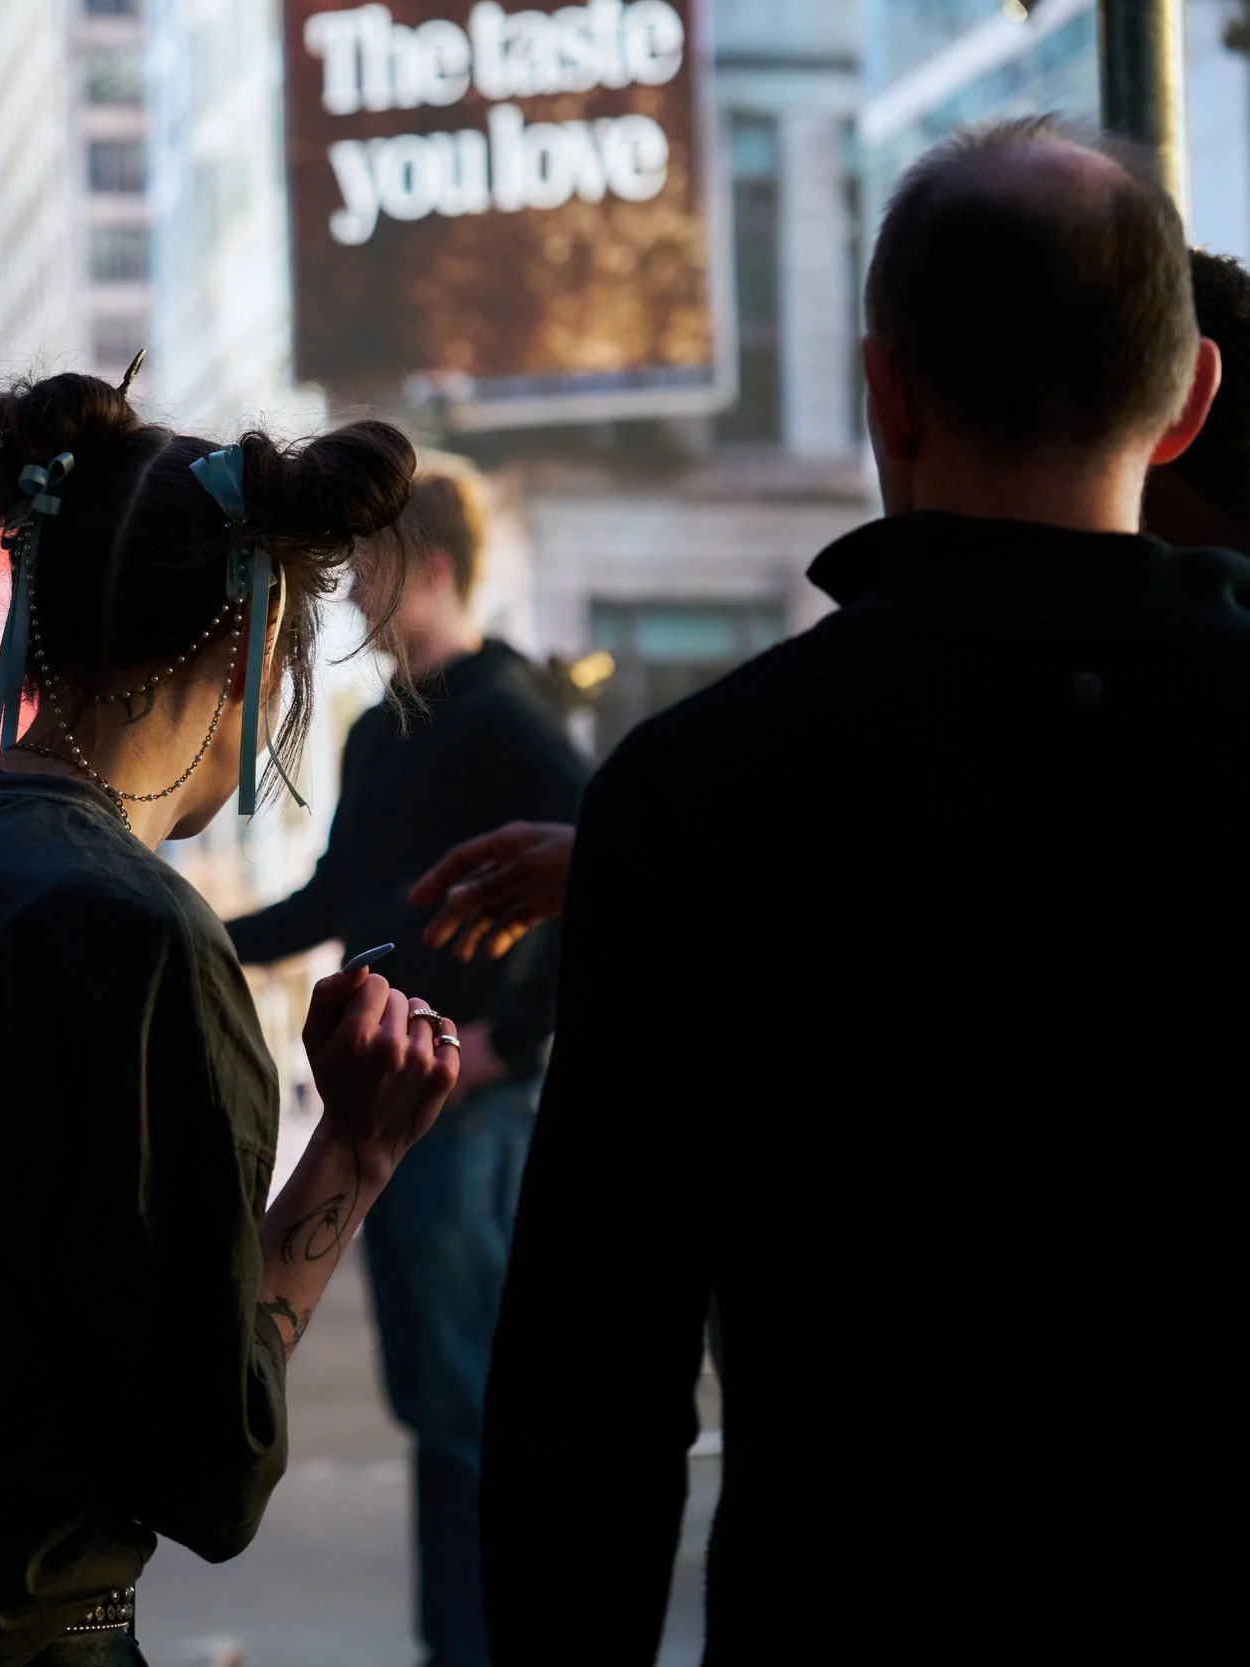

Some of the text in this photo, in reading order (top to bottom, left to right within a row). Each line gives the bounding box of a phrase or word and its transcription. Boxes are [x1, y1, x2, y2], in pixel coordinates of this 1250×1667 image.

[305, 0, 683, 115] The taste
[329, 103, 668, 245] you love
